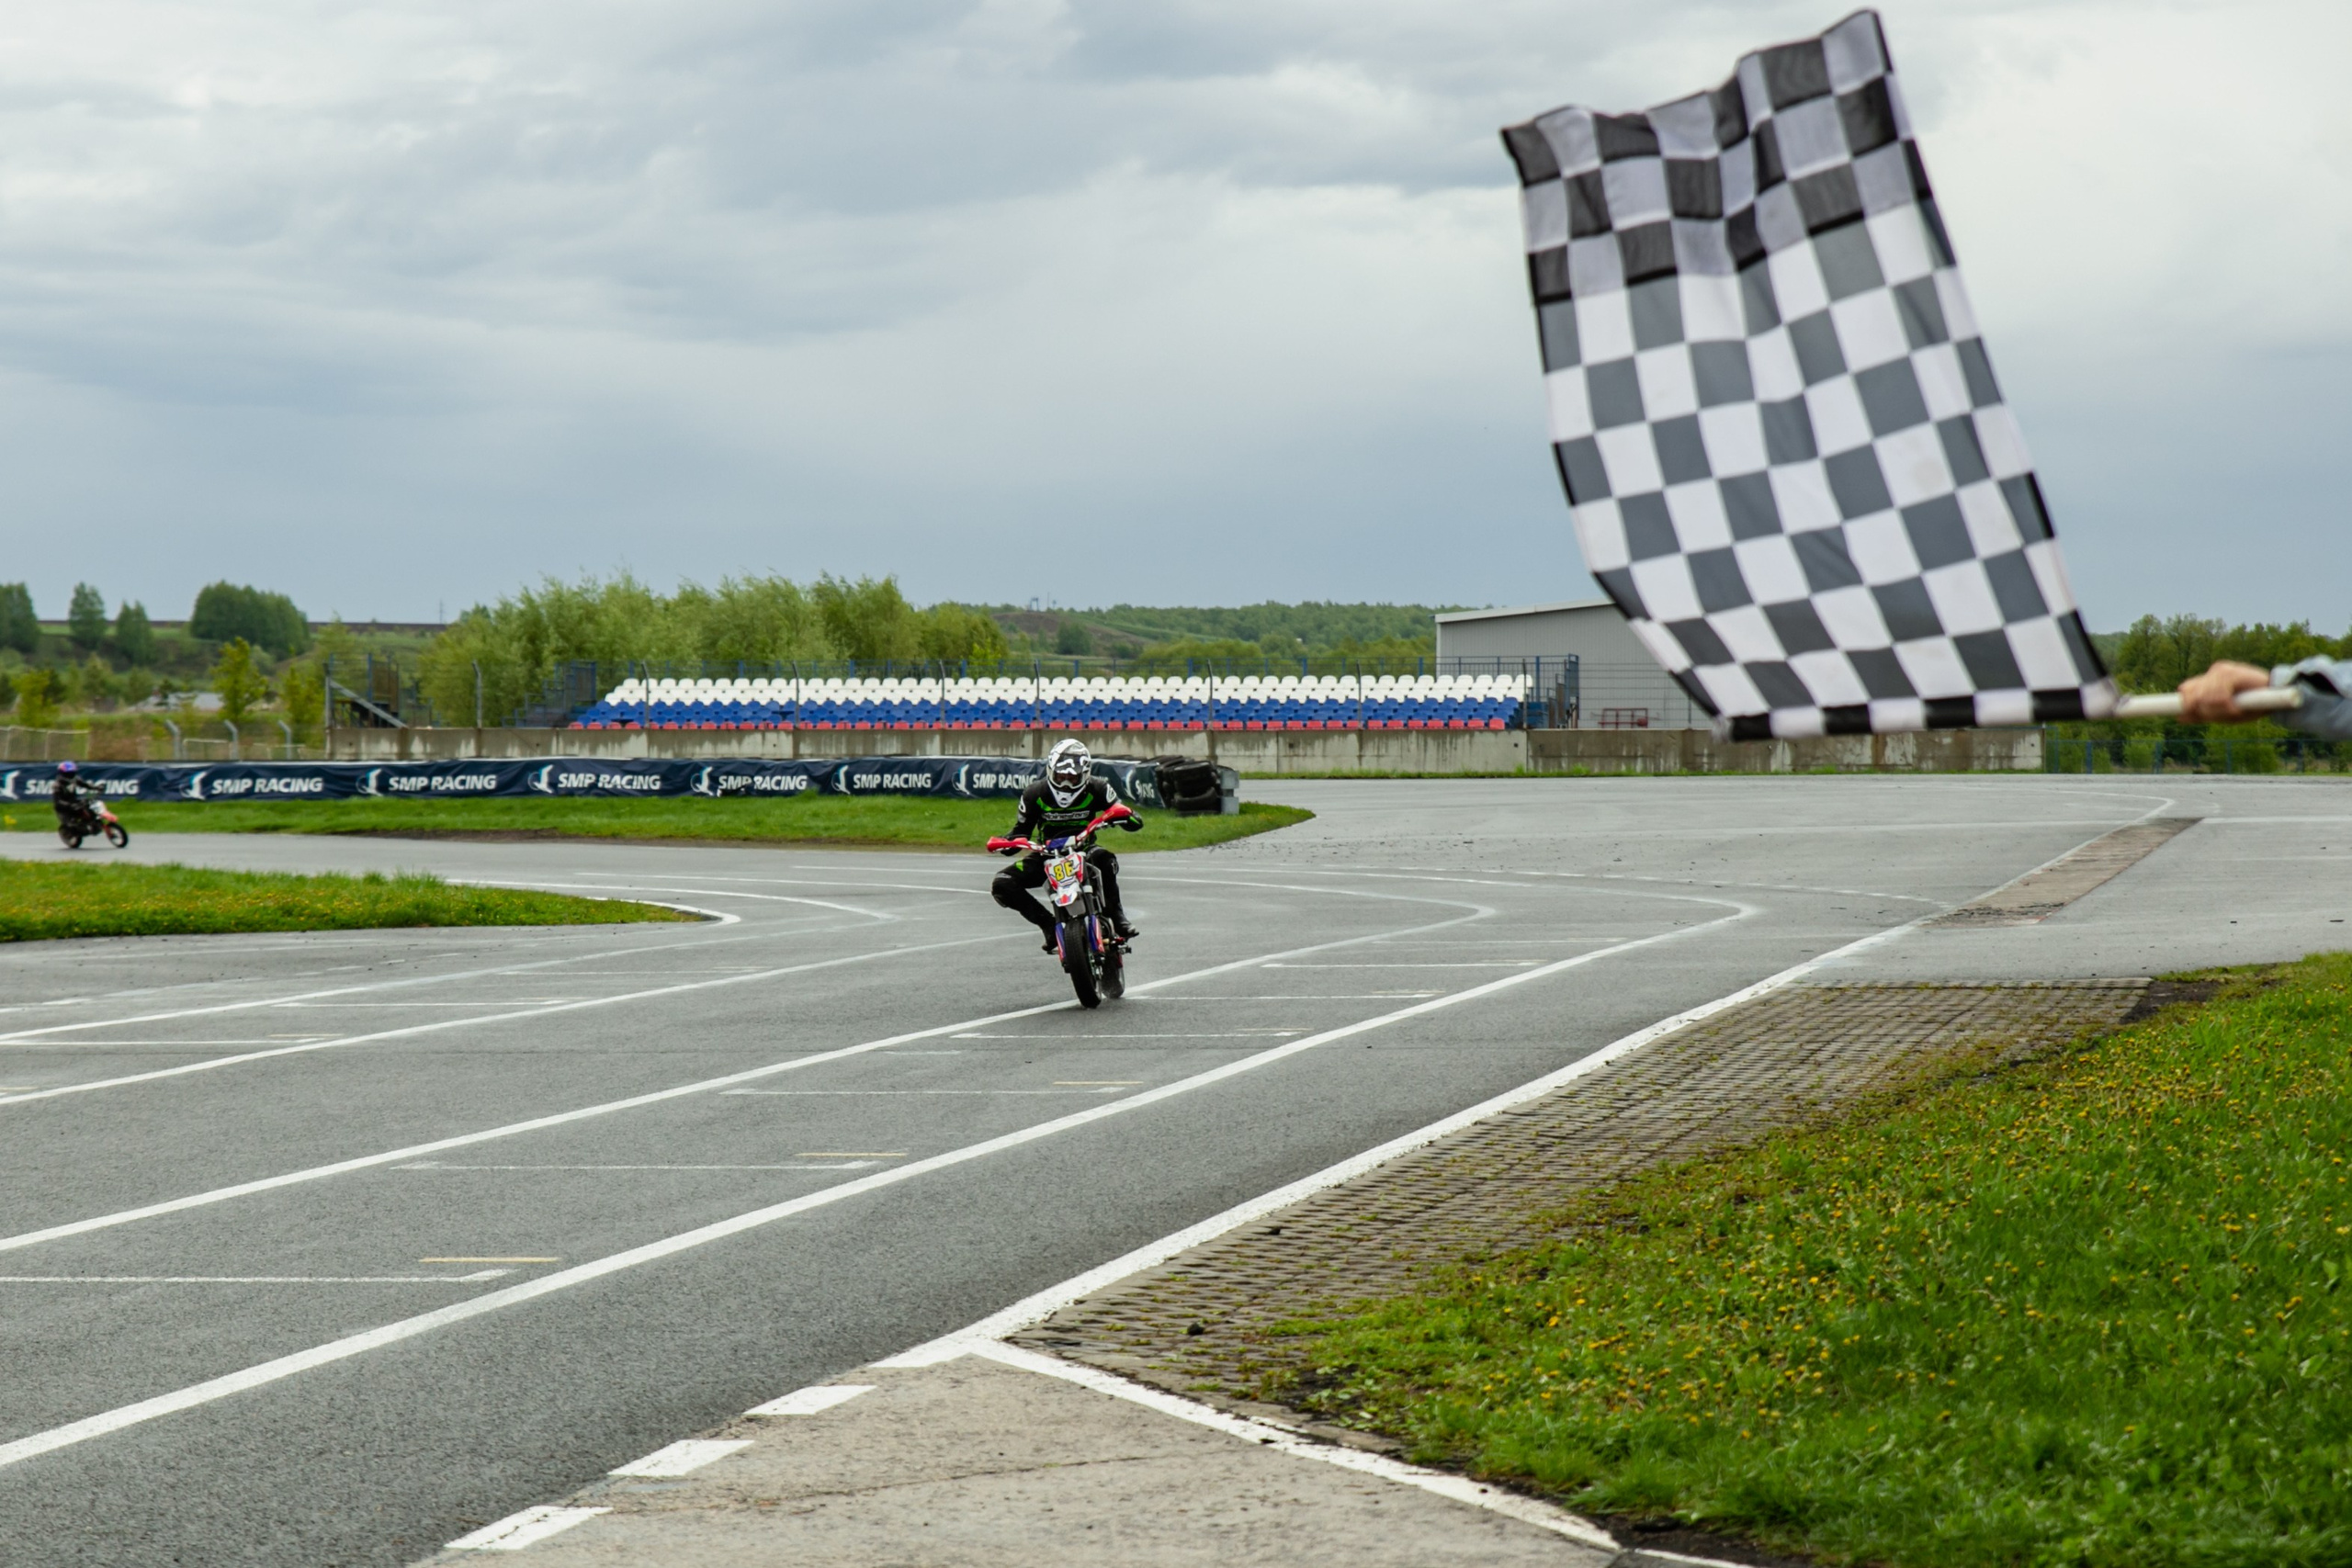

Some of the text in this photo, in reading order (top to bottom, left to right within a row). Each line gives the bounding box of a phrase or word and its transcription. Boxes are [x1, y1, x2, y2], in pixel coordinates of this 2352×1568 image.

[25, 779, 55, 795] SM
[211, 777, 323, 795] SMP RACING
[389, 774, 497, 791] SMP RACING
[558, 773, 662, 790] SMP RACING
[718, 774, 808, 791] SMP RACING
[854, 773, 932, 789] SMP RACING
[972, 773, 997, 789] SMP
